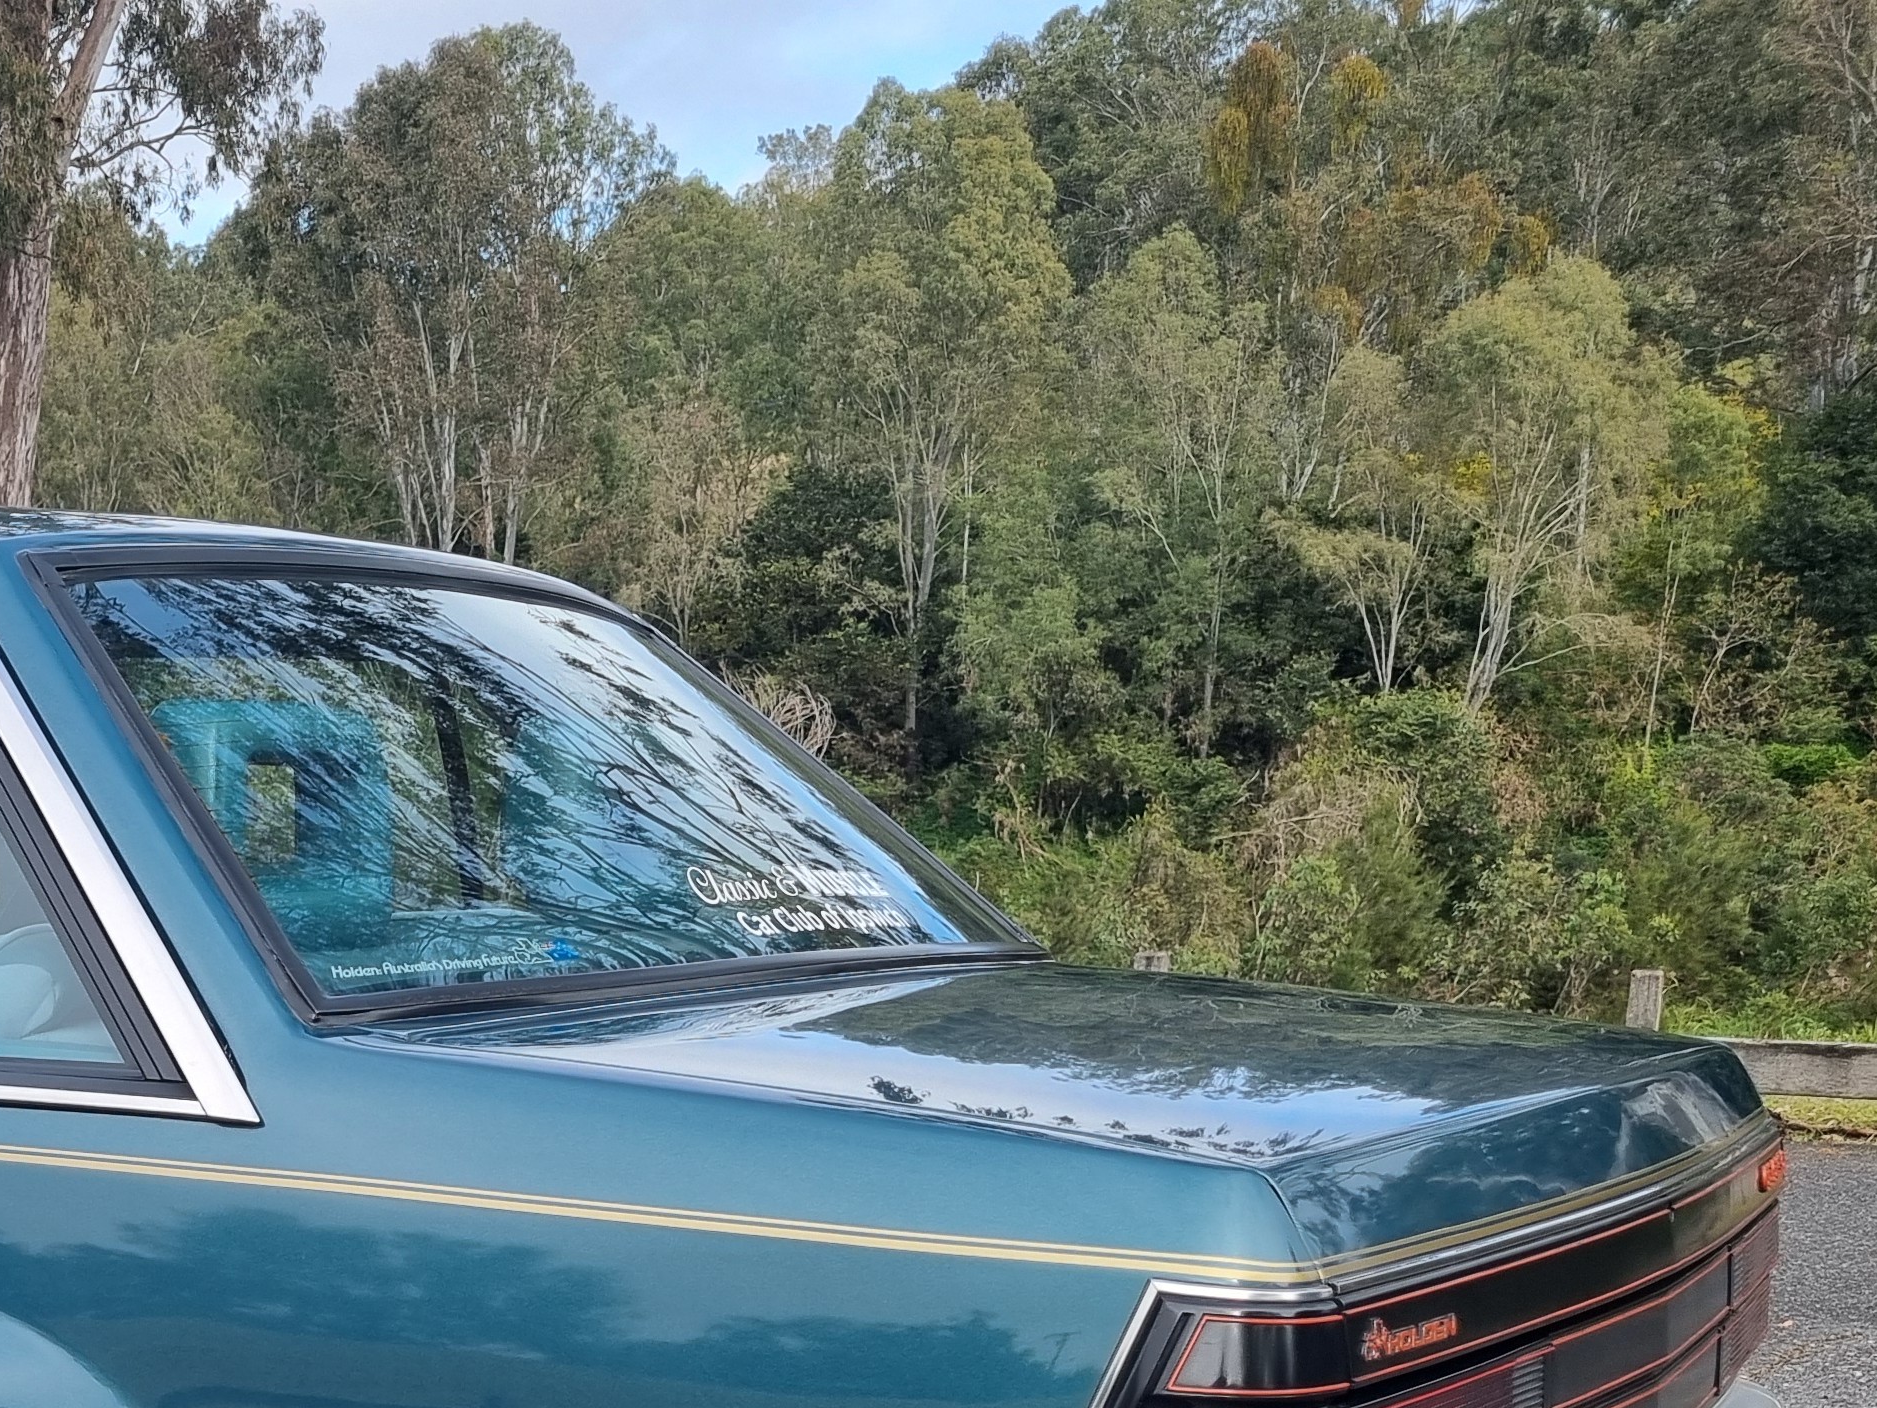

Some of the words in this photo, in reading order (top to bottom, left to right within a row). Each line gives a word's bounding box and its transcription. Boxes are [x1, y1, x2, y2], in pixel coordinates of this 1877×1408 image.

[686, 866, 777, 905] Classic
[771, 866, 799, 897] &
[736, 911, 781, 937] Car
[773, 904, 825, 933] Club
[820, 903, 850, 930] of
[836, 902, 912, 935] Ipswich
[330, 965, 383, 979] Holden:
[442, 957, 484, 971] Driving
[1385, 1312, 1457, 1356] HOLDEN
